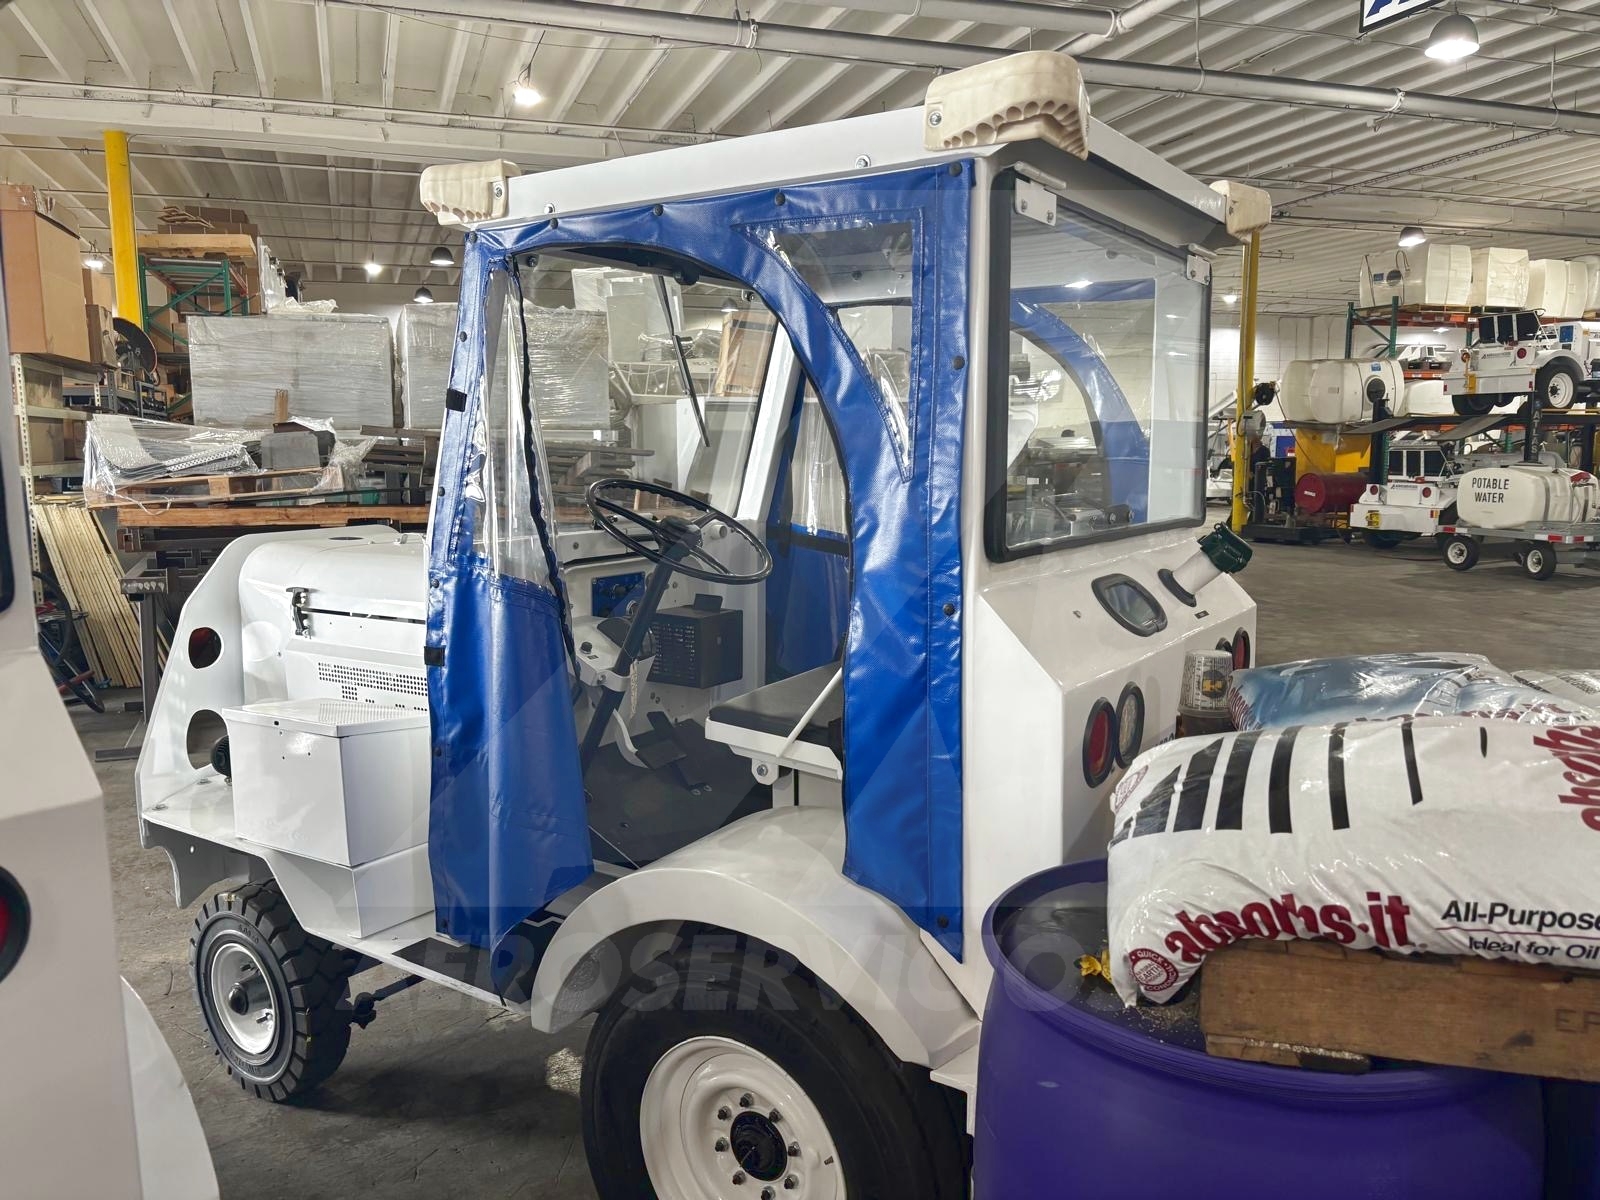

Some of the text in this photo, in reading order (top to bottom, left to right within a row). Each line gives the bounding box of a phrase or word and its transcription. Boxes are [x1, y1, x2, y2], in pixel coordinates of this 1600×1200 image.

[1531, 410, 1541, 453] ATLAS
[1472, 477, 1510, 490] POTABLE
[1474, 492, 1504, 503] WATER
[1469, 936, 1520, 954] Ideal
[1526, 941, 1560, 956] for
[1136, 950, 1165, 964] QUICK
[1138, 965, 1163, 981] EARTH
